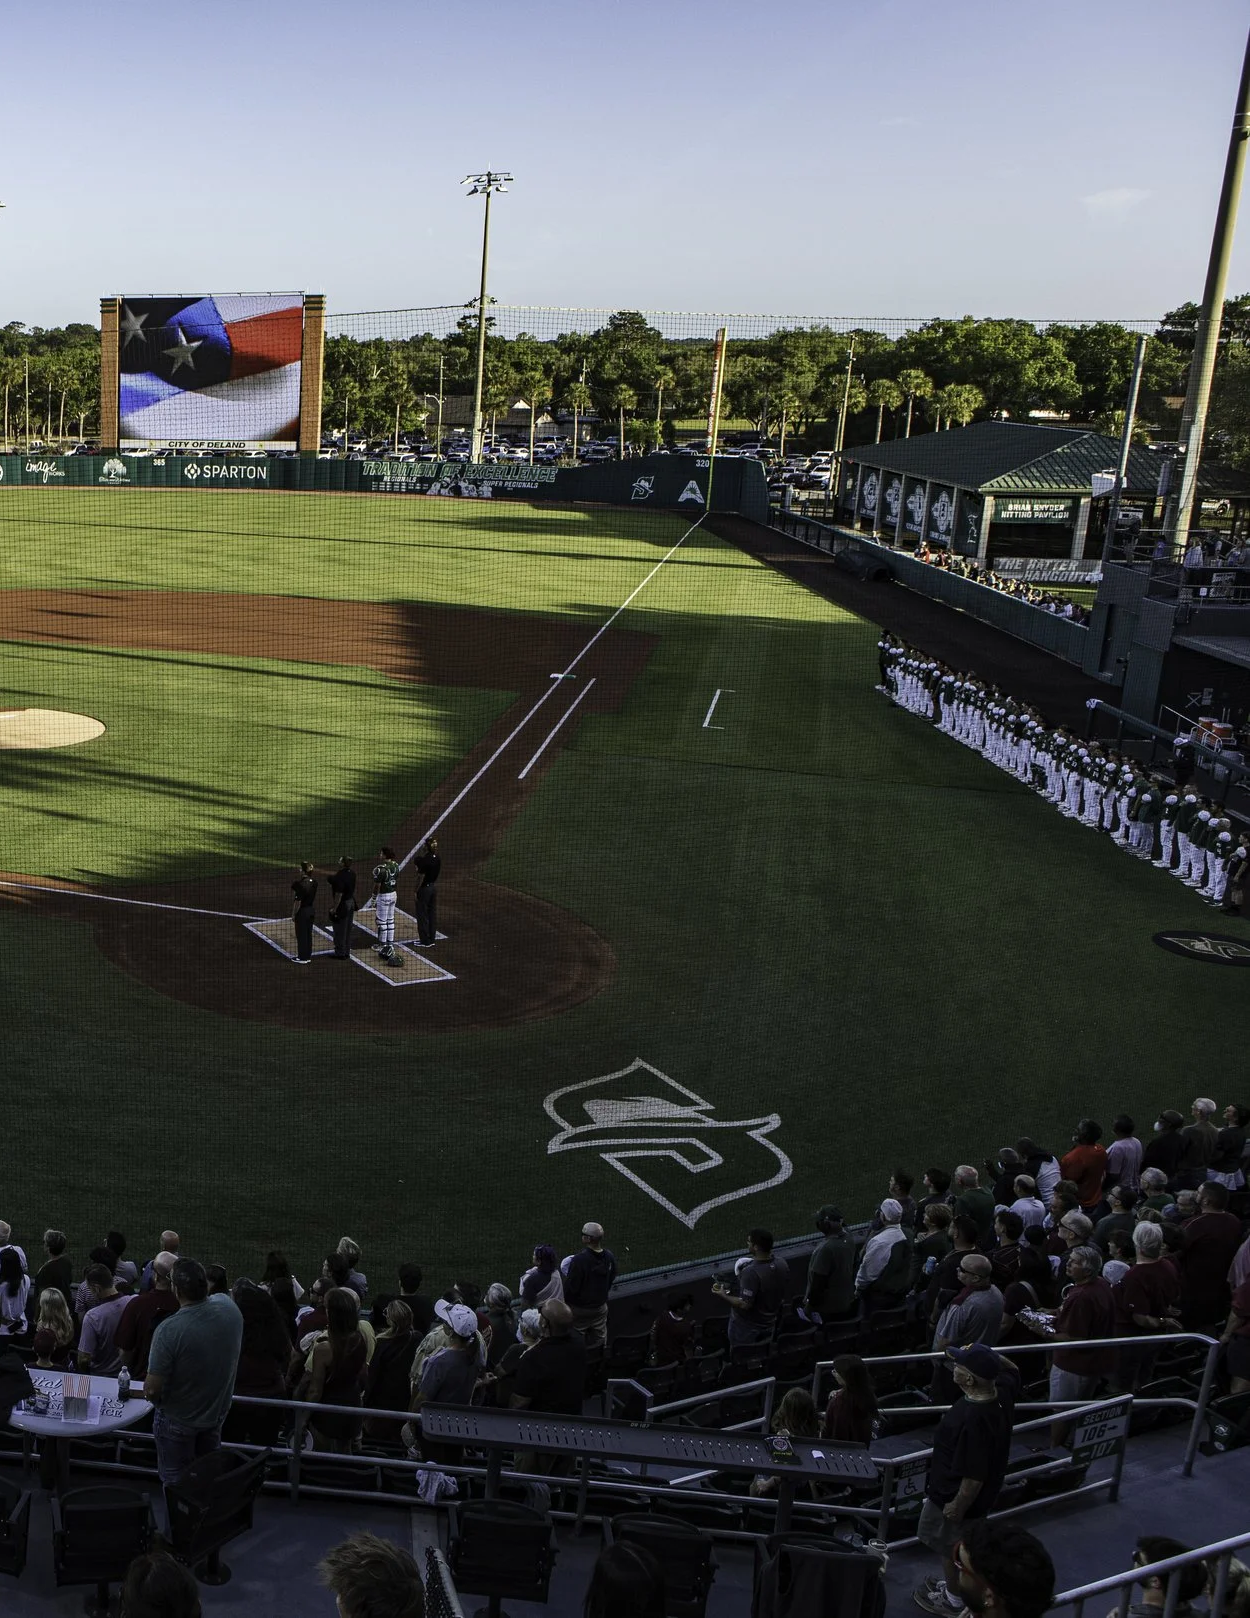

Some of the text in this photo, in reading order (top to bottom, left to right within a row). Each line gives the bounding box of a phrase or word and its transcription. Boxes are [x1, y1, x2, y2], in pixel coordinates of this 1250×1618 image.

[695, 459, 710, 468] 320
[203, 465, 267, 479] SPARTON
[362, 461, 439, 477] TRADITION
[463, 464, 558, 482] EXCELLENCE
[504, 481, 539, 489] REGIONALS
[1034, 511, 1069, 519] PAVILION
[998, 558, 1080, 571] THE HATTER
[1083, 1405, 1123, 1425] SECTION
[1081, 1423, 1108, 1443] 106
[1090, 1439, 1116, 1460] 107
